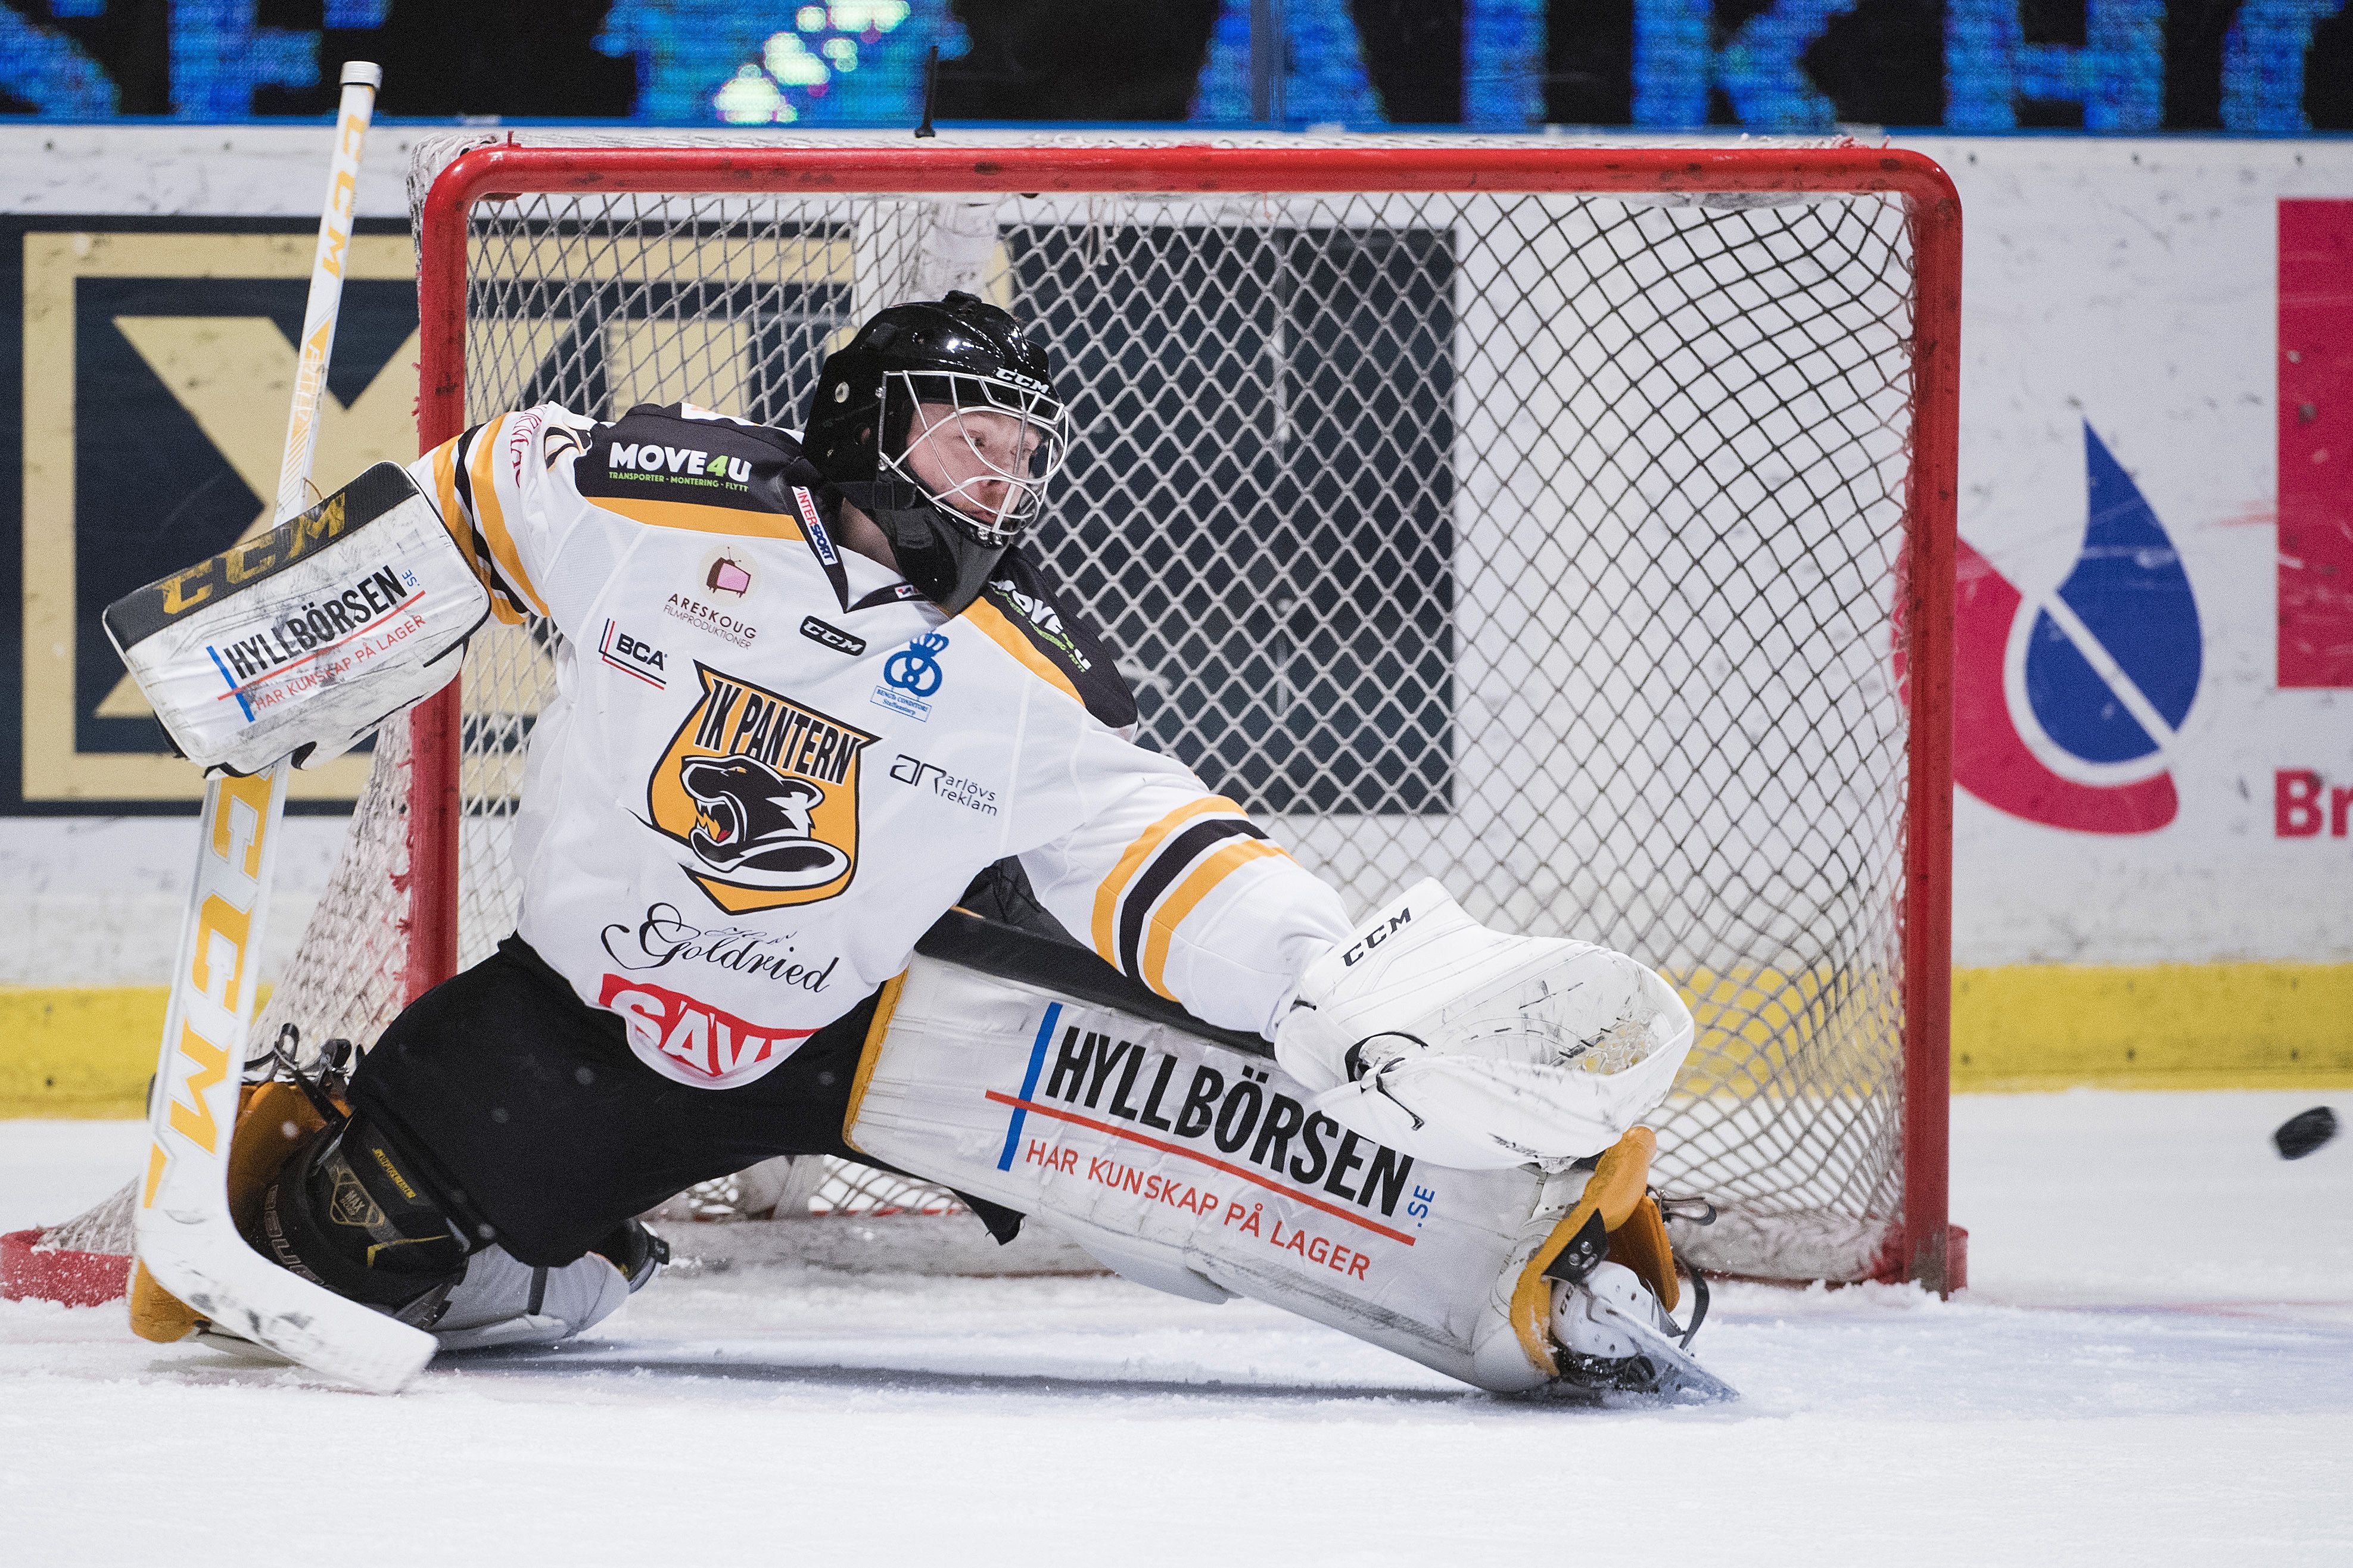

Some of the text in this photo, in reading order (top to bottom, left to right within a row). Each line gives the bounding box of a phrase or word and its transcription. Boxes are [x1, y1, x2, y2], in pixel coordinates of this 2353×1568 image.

[994, 367, 1050, 393] CCM
[609, 442, 752, 483] MOVE4U
[609, 471, 749, 492] TRANSPORTER MONTERING FLYTT
[797, 490, 836, 563] INTERSPORT
[157, 492, 346, 615] CCM
[223, 565, 407, 679] HYLLBÖRSEN
[663, 604, 752, 650] FILMPRODUKTIONER
[668, 593, 757, 640] ARESKOUG
[802, 621, 863, 653] CCM
[255, 614, 427, 712] HAR KUNSKAP PÅ LAGER
[616, 633, 664, 671] BCA
[695, 677, 860, 785] IK PANTERN
[941, 787, 998, 817] reklam
[946, 775, 997, 802] arlövs
[170, 772, 273, 1154] CCM
[1341, 907, 1412, 967] CCM
[1045, 1025, 1415, 1218] HYLLBÖRSEN
[1026, 1139, 1372, 1282] HAR KUNSKAP PÅ LAGER
